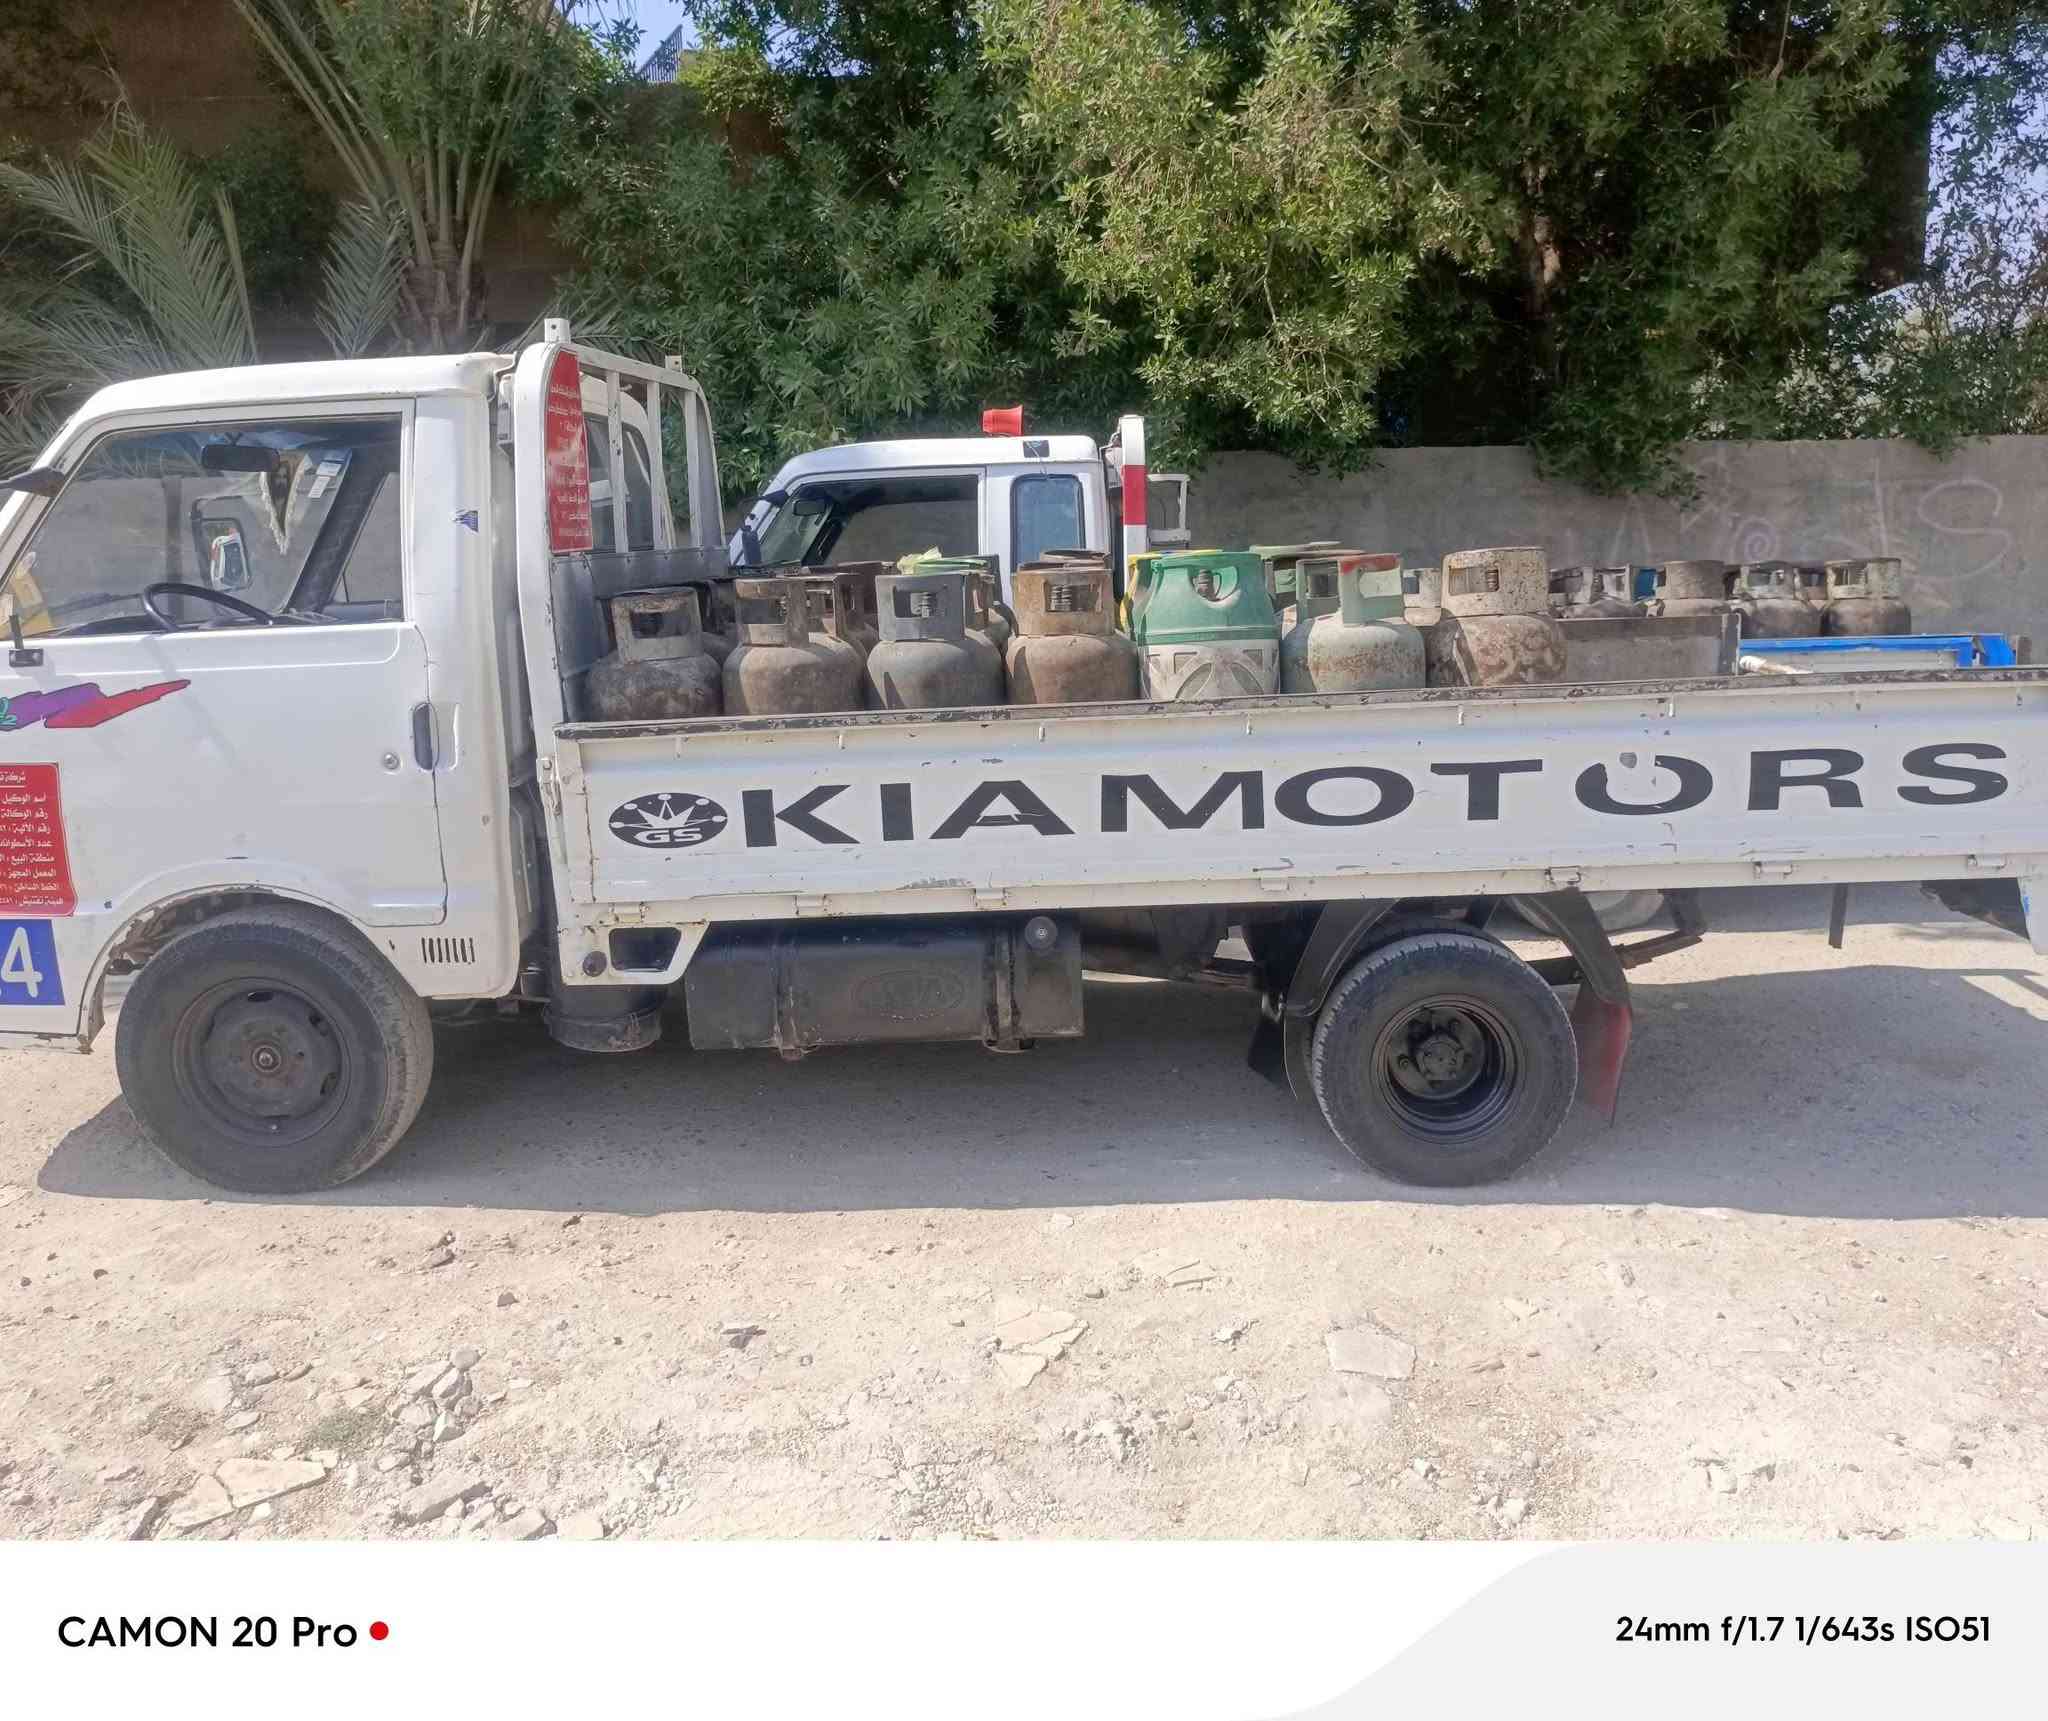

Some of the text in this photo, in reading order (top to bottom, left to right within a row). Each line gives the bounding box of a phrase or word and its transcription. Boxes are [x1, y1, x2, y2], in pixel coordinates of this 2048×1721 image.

[742, 743, 2008, 847] KIA MOTORS
[634, 827, 703, 844] GS
[0, 926, 43, 998] 4
